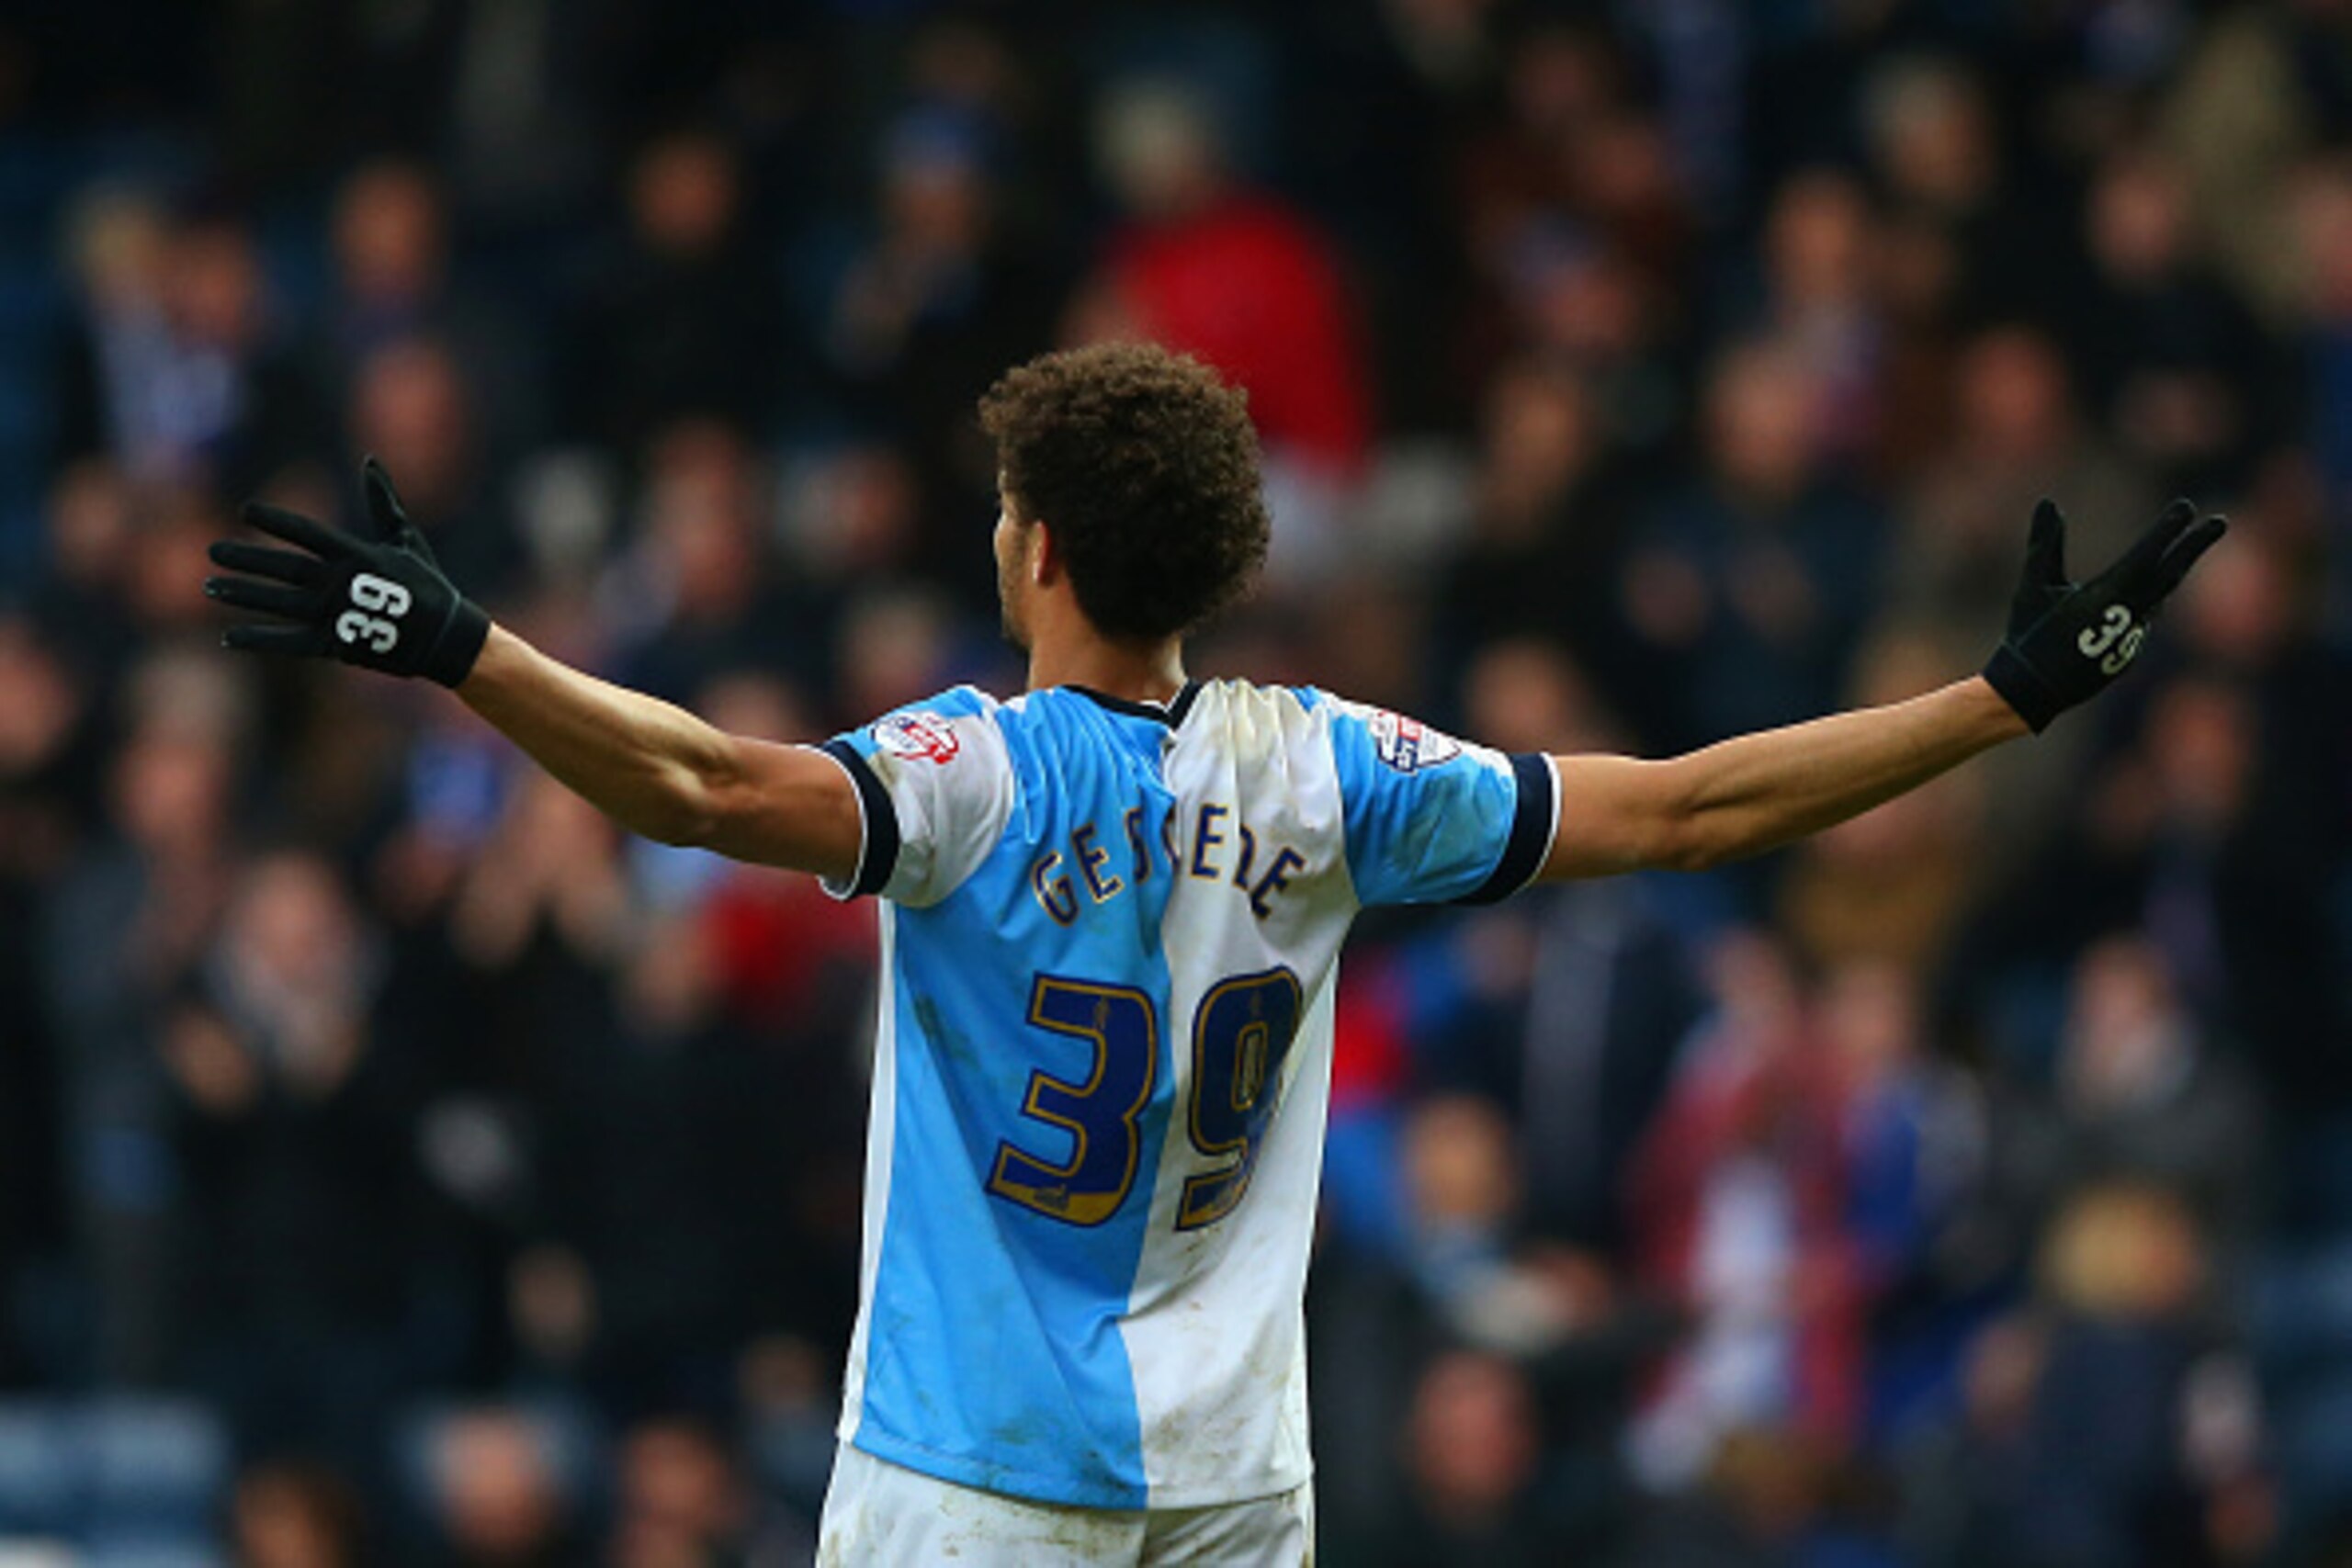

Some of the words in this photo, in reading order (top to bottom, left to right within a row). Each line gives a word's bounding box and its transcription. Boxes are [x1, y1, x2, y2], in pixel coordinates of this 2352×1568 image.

[336, 573, 412, 653] 39
[2078, 604, 2143, 675] 39
[983, 964, 1303, 1232] 39
